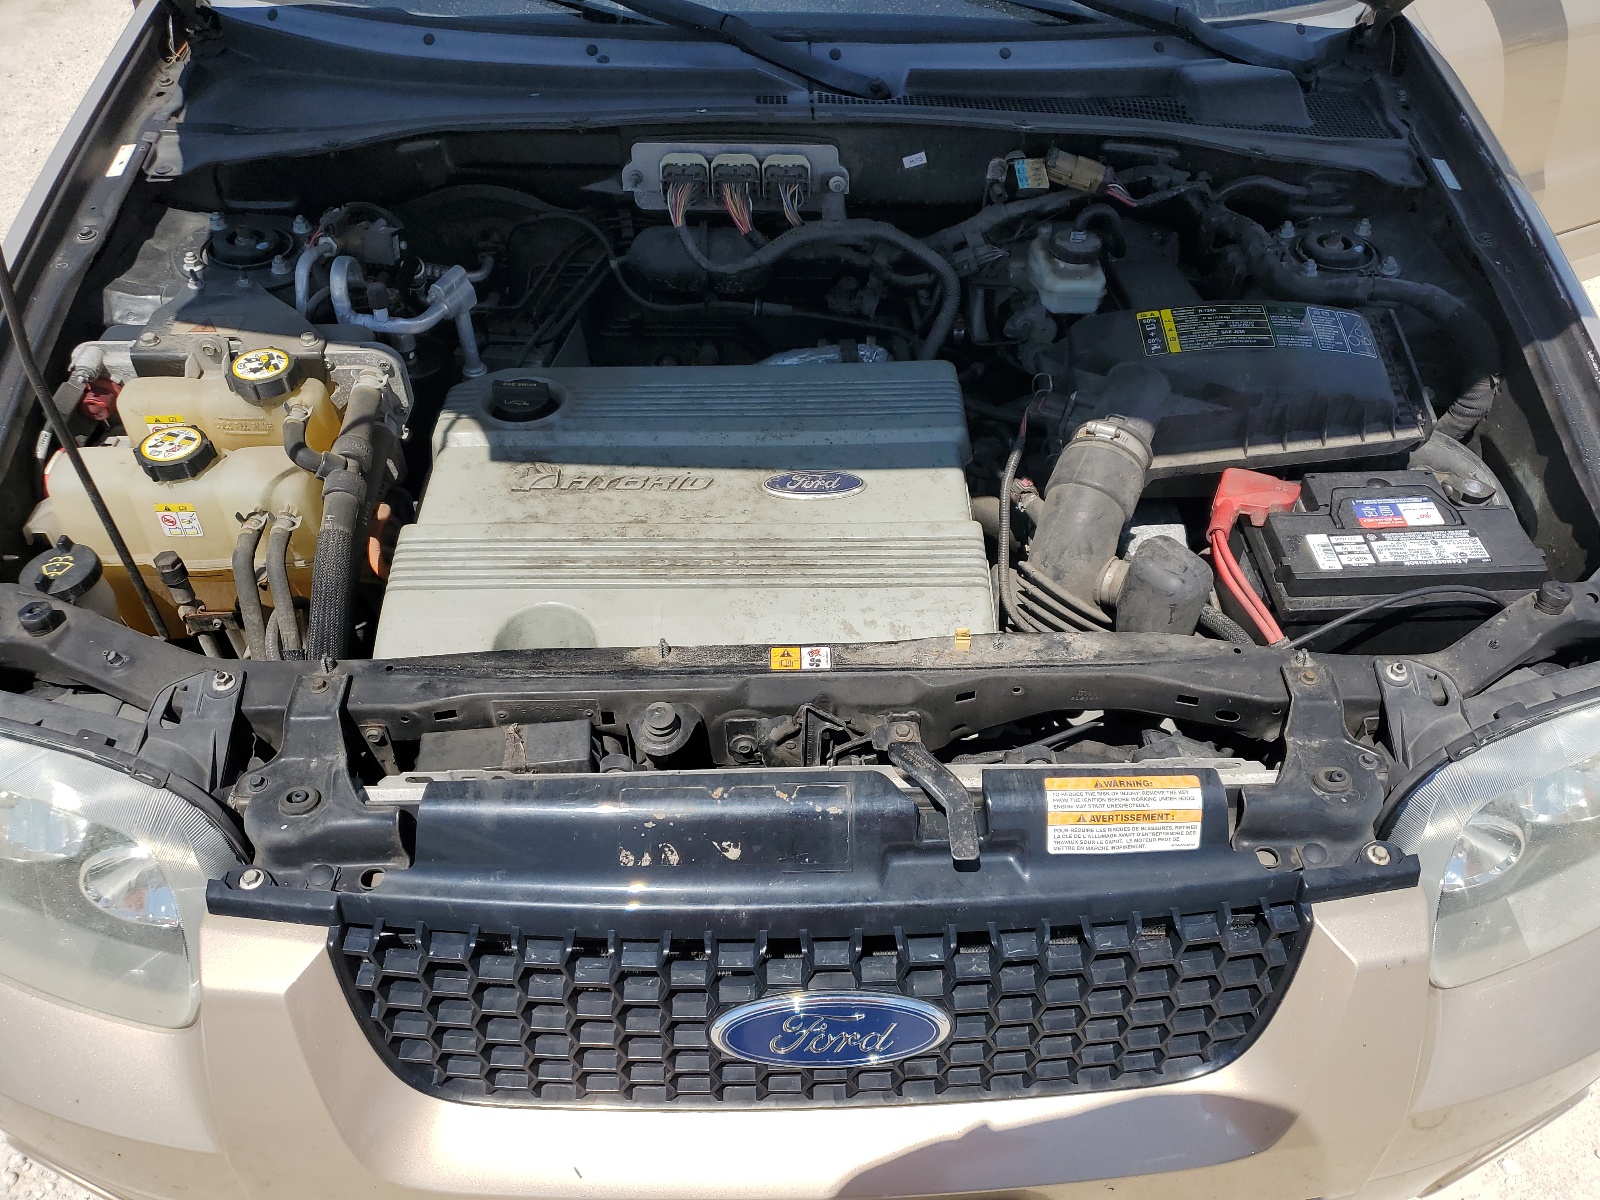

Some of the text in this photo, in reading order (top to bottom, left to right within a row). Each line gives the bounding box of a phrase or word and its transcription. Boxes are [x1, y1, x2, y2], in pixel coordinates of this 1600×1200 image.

[560, 471, 715, 491] HYBRID
[786, 471, 842, 491] Ford
[769, 1013, 898, 1054] Ford
